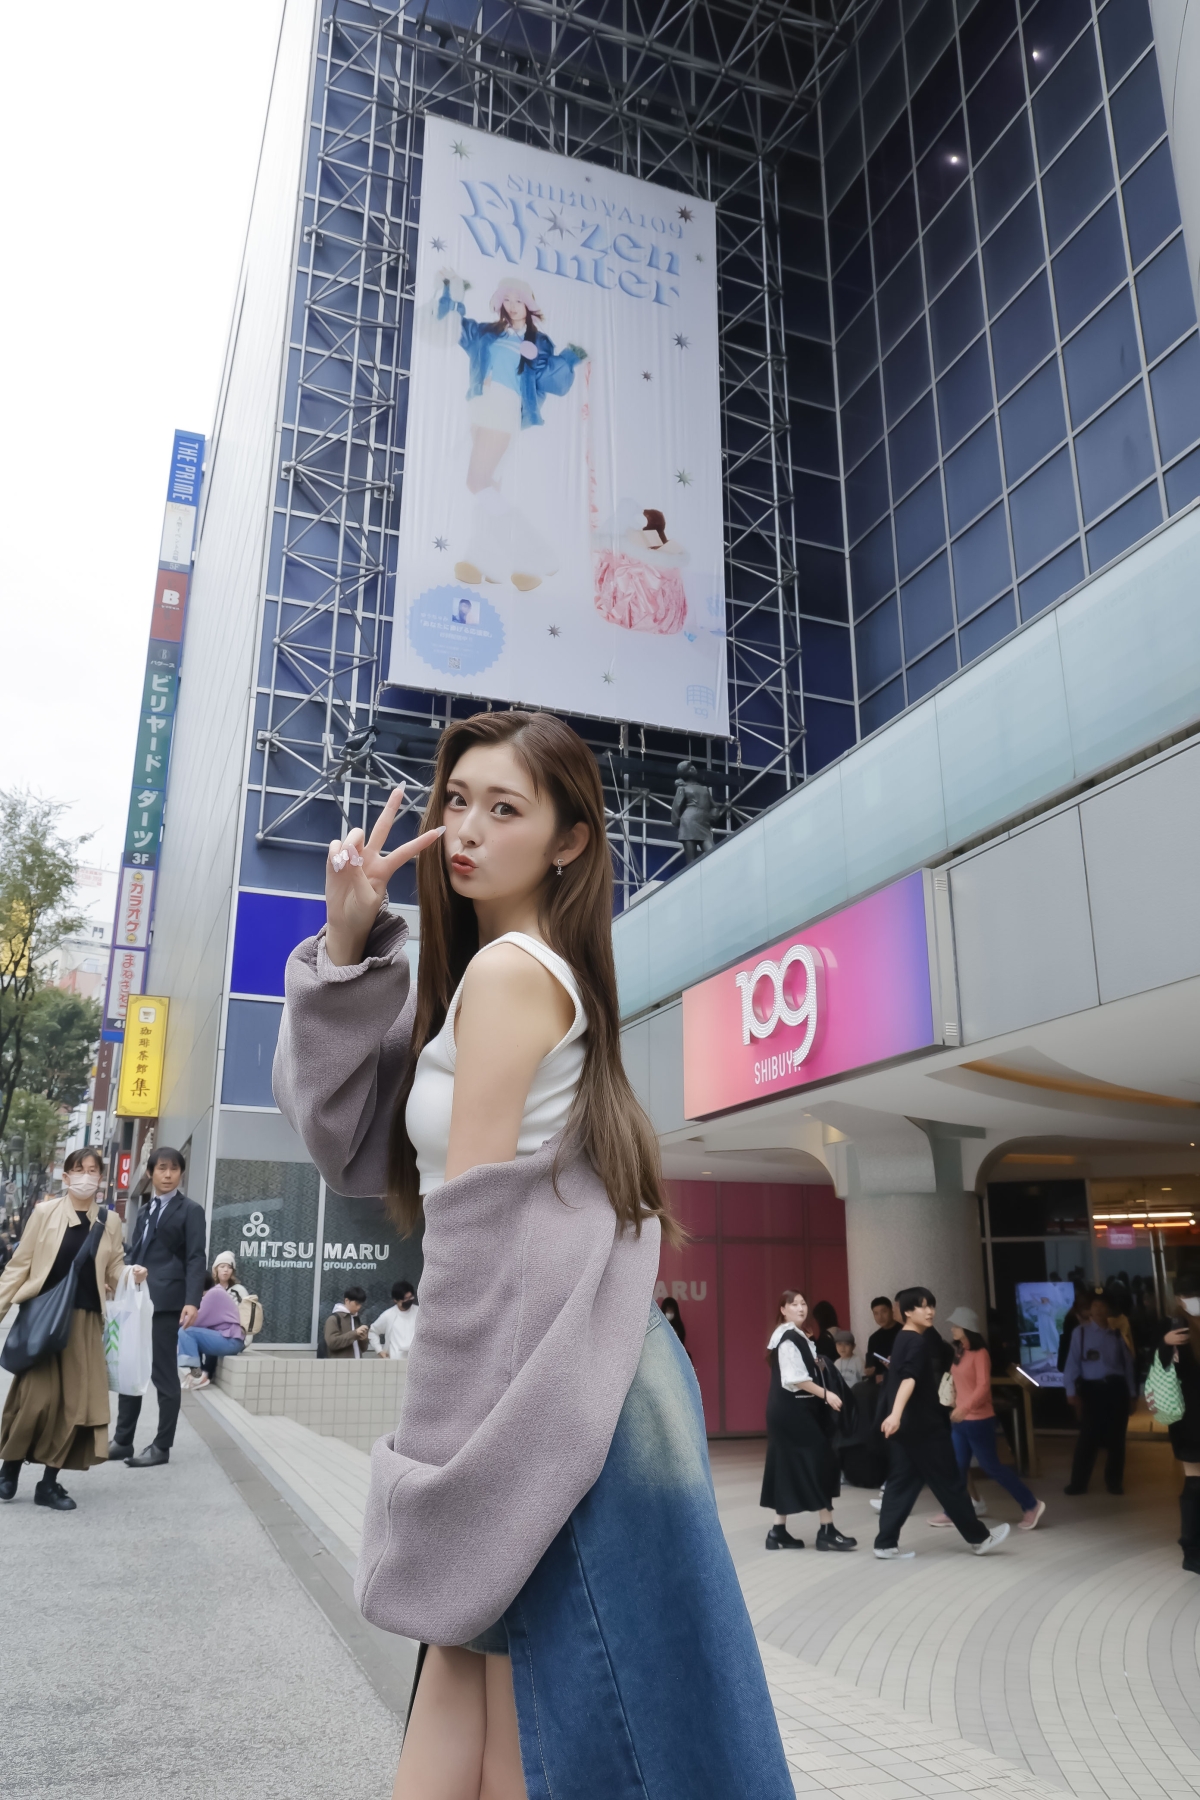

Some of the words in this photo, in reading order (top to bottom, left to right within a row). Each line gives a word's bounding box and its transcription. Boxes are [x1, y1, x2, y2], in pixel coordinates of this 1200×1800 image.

[460, 179, 681, 277] Frzen
[507, 174, 684, 240] SHIBUYA109
[460, 213, 681, 308] Winter
[177, 441, 199, 463] THE
[172, 463, 196, 502] PRIME
[162, 589, 180, 605] B
[133, 674, 172, 848] ビリヤード・ダーツ
[132, 852, 149, 865] 3F
[127, 882, 144, 933] カラオケ
[735, 944, 818, 1067] 109
